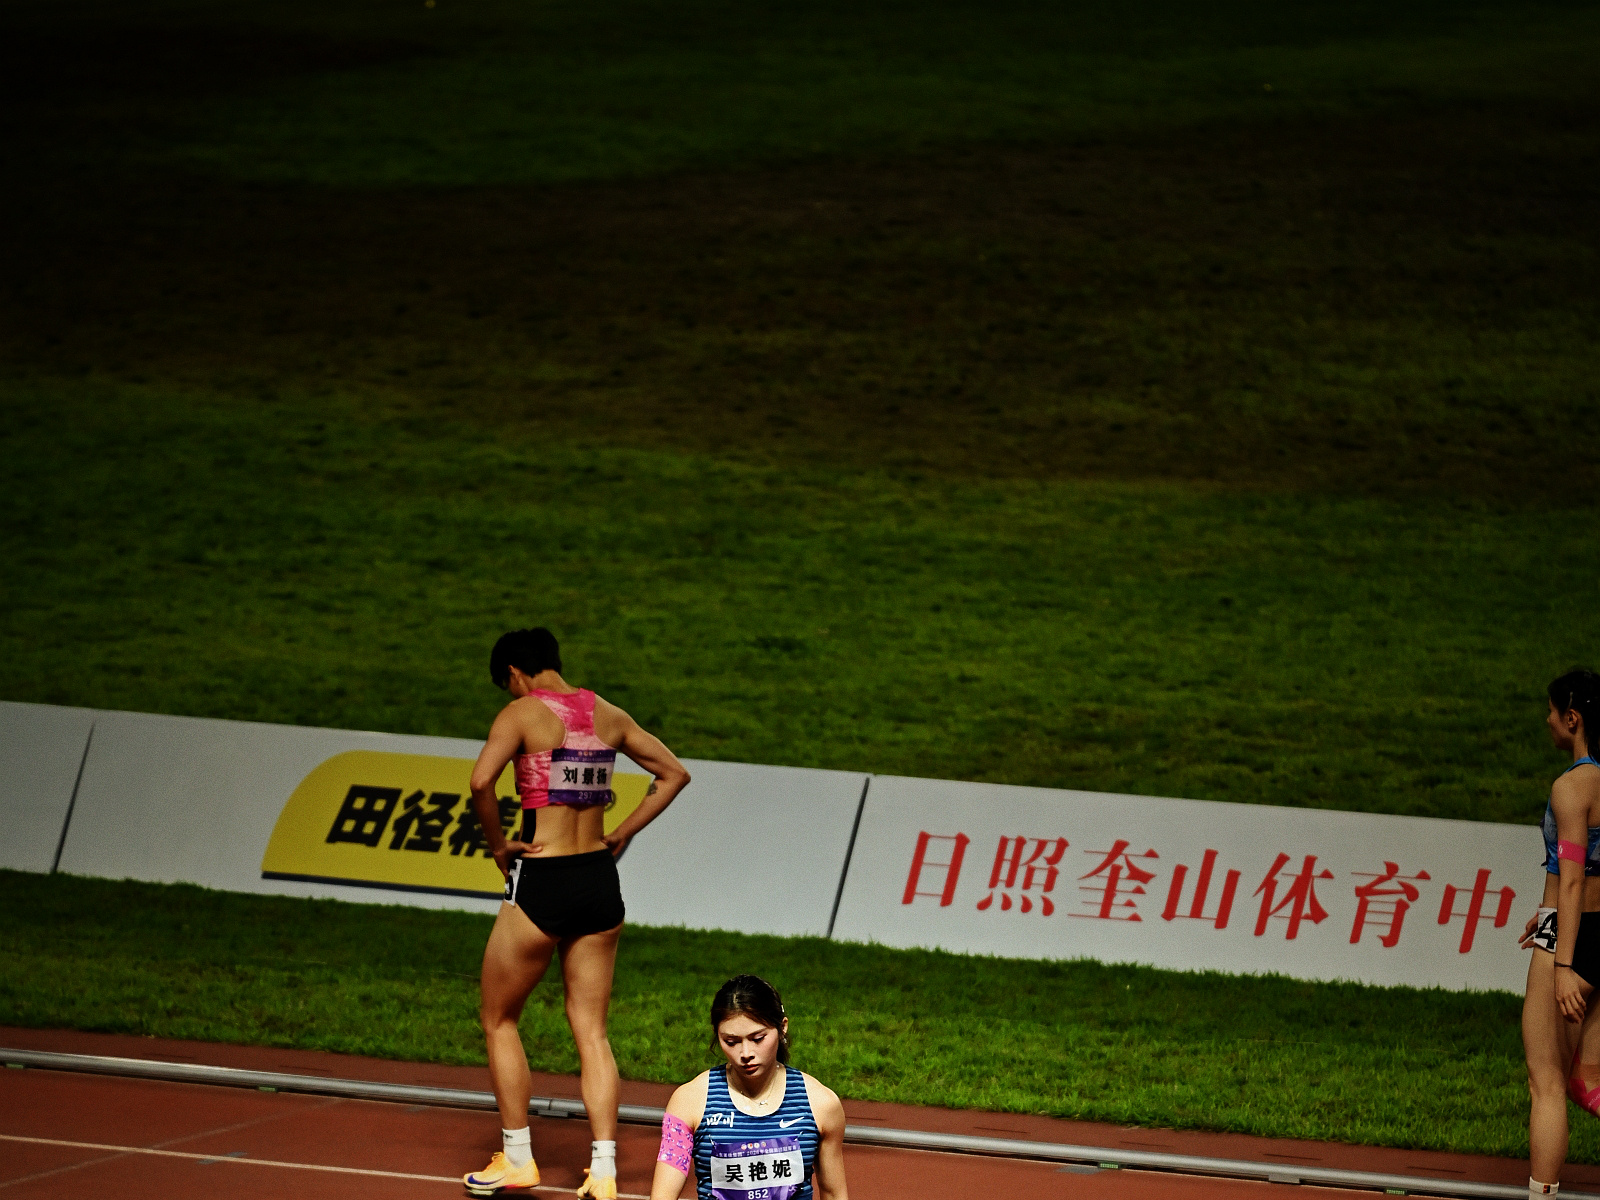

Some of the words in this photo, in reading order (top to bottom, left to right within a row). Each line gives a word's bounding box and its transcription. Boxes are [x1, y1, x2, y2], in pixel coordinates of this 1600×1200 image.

[901, 831, 1516, 954] 日照奎山体育中
[725, 1159, 792, 1183] 吴艳妮
[748, 1189, 769, 1200] 852
